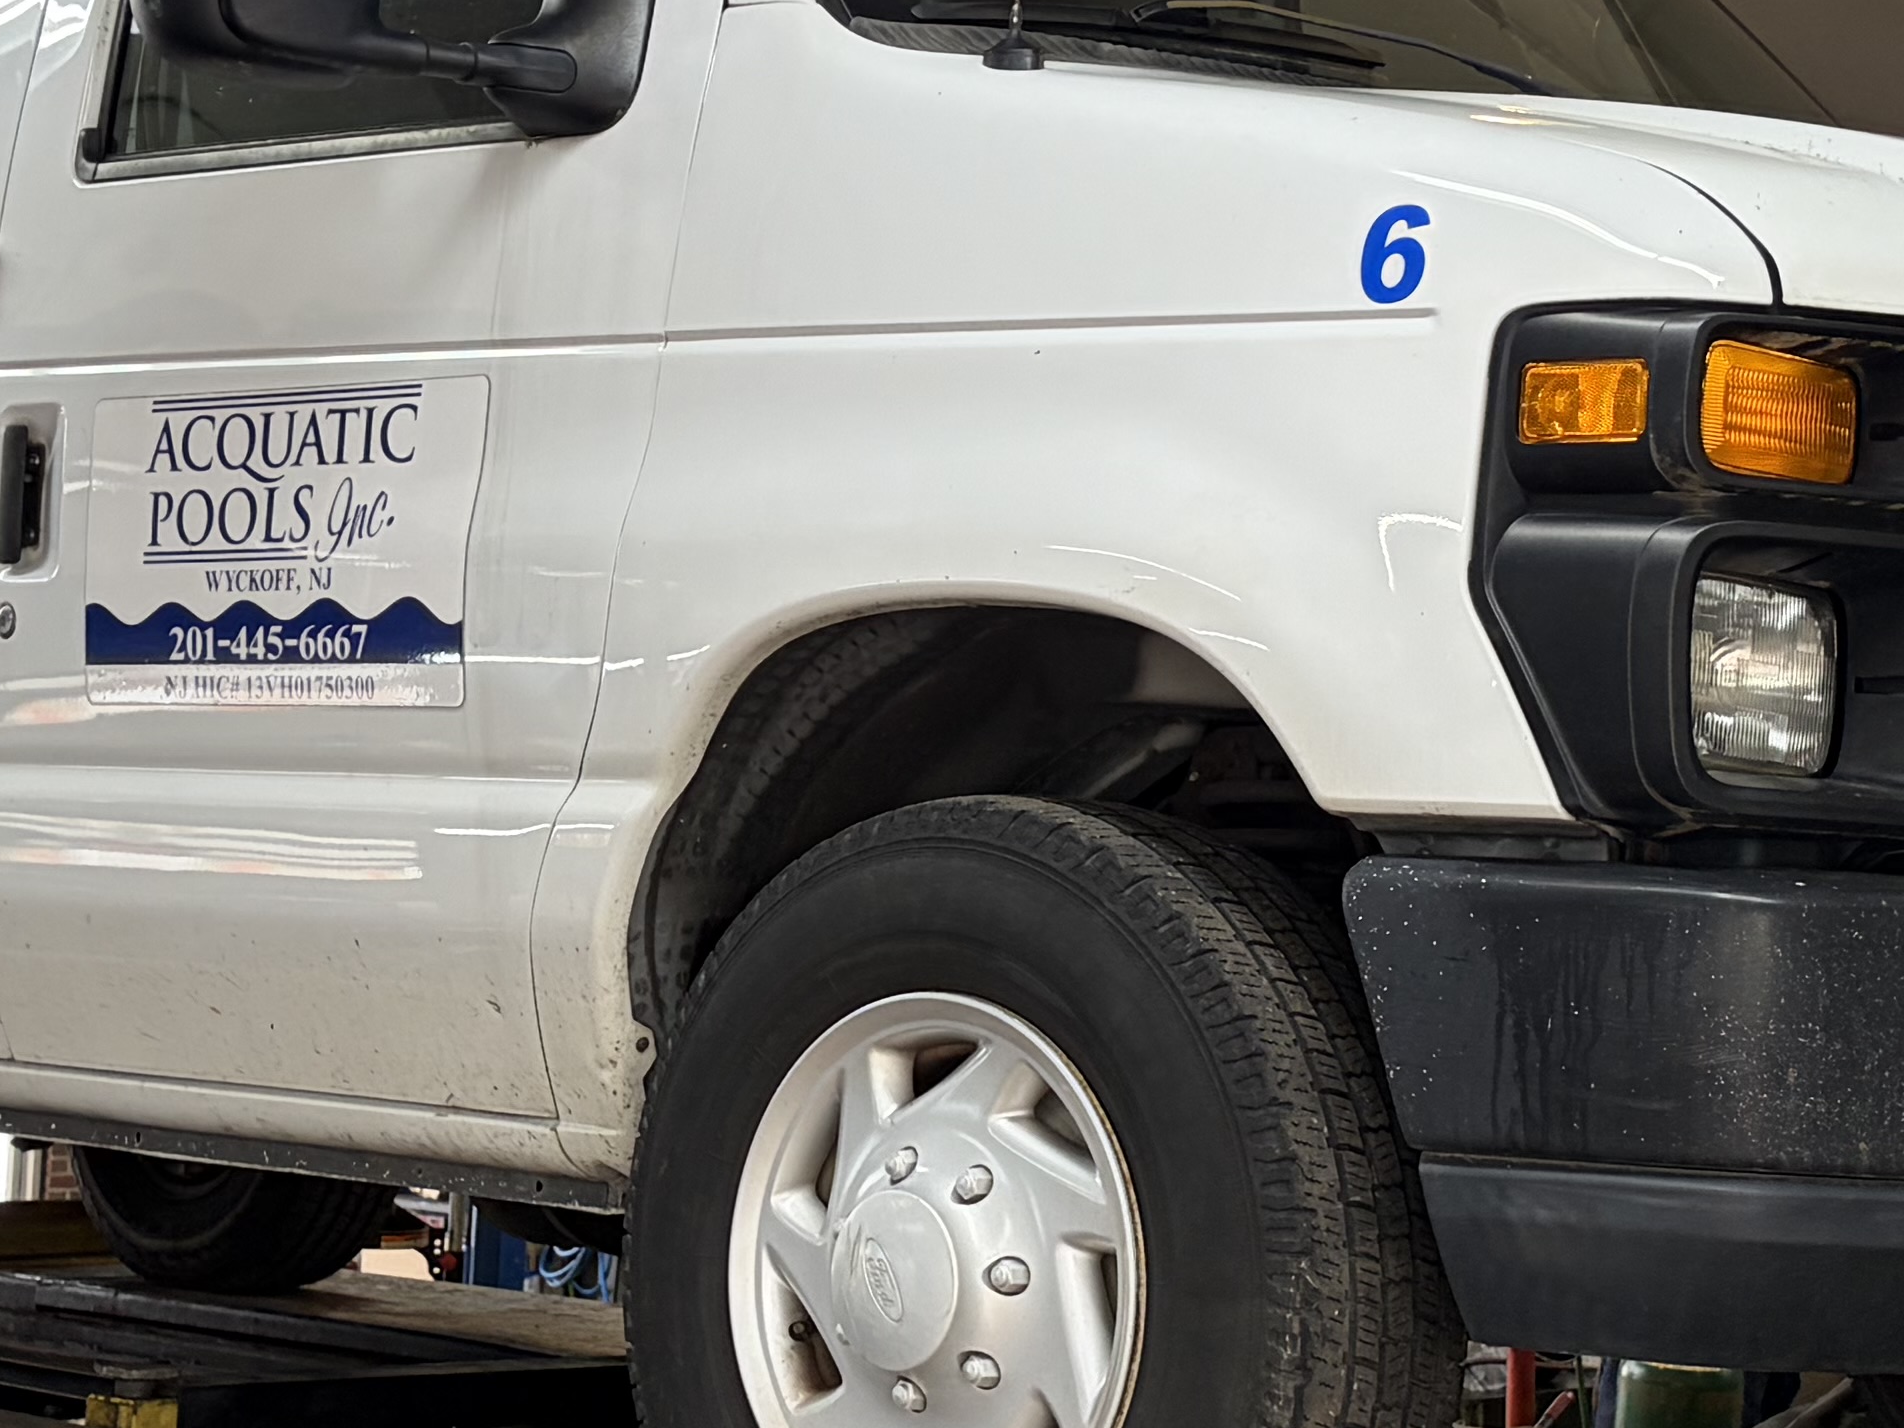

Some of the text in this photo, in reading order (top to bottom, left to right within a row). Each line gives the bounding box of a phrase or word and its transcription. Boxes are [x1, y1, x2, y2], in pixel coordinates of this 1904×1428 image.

[1361, 204, 1431, 304] 6
[145, 404, 419, 483] ACQUATIC
[148, 477, 395, 562] POOLS Inc.
[205, 567, 333, 595] WYCKOFF, NJ
[168, 624, 369, 661] 201-445-6667
